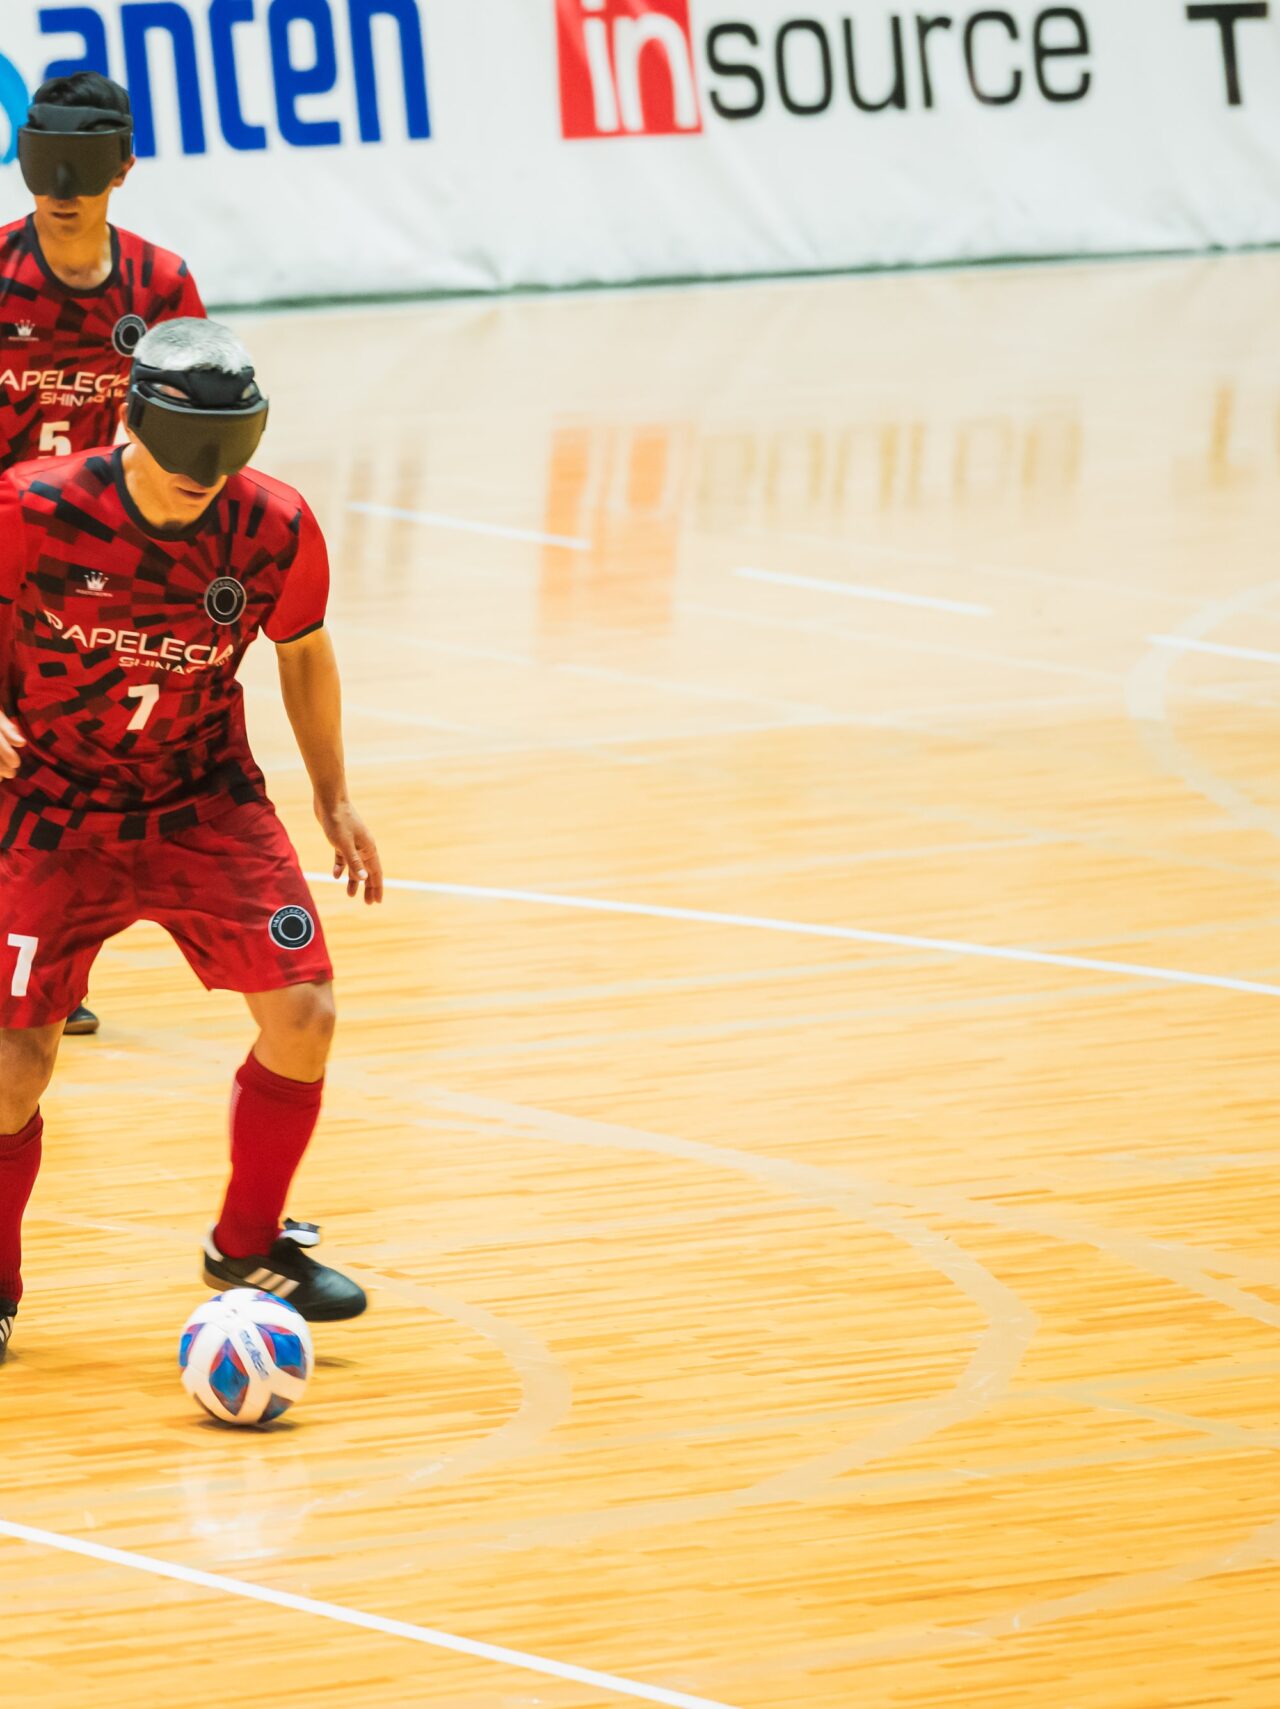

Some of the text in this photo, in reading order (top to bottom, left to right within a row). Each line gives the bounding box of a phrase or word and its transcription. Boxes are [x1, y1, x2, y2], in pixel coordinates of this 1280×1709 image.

[580, 0, 1094, 134] insource
[1185, 2, 1268, 106] T
[38, 421, 72, 460] 5
[126, 683, 160, 731] 7
[7, 933, 39, 997] 7
